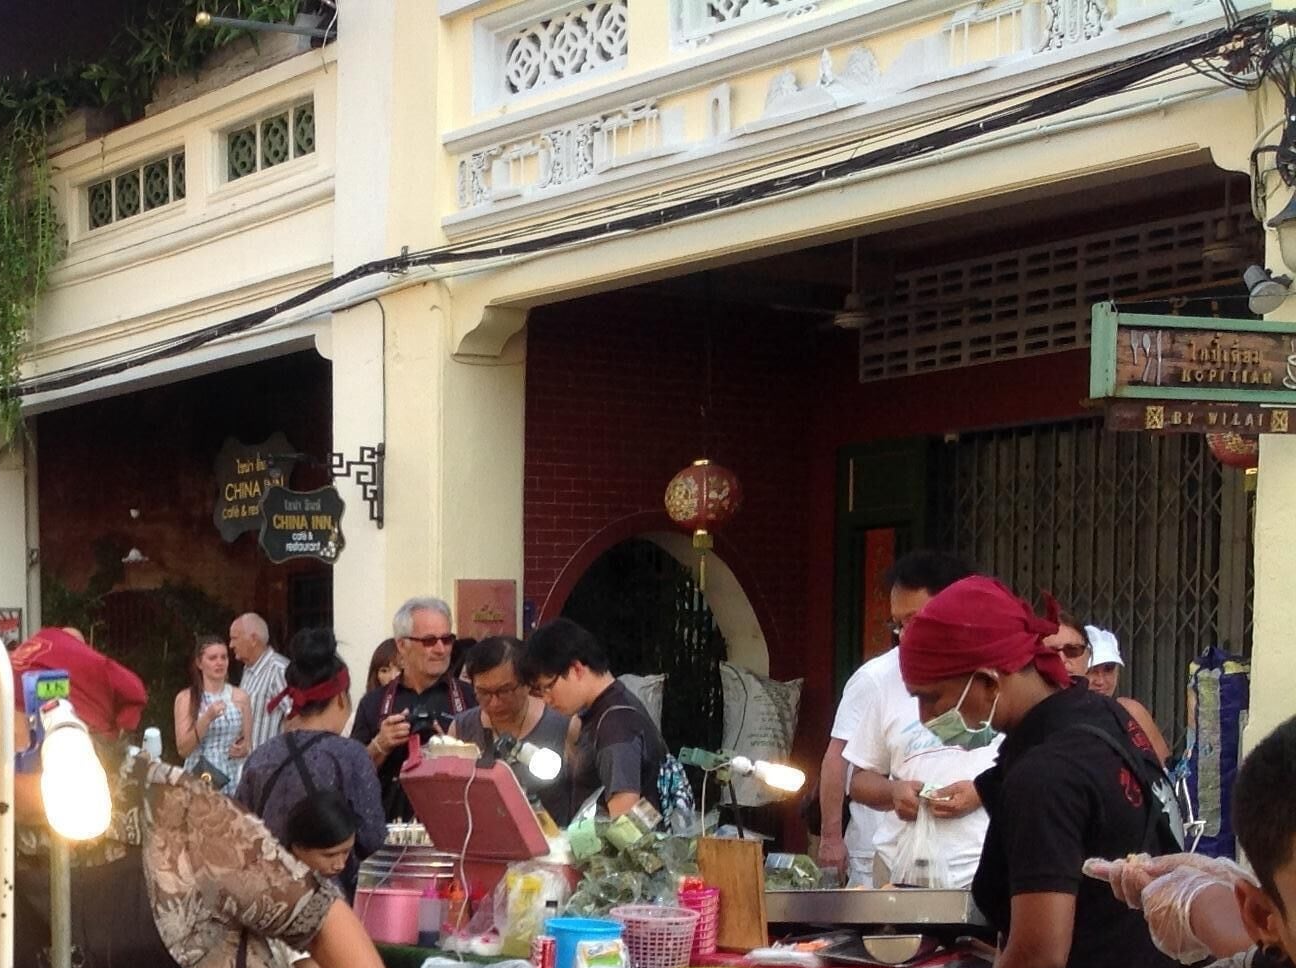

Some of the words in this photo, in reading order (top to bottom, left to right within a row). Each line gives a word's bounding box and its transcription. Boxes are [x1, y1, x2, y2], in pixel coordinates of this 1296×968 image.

[1181, 367, 1273, 385] KOPITIAM
[1172, 410, 1194, 425] BY
[1207, 411, 1265, 427] WILAI
[225, 480, 262, 502] CHINA
[240, 504, 248, 517] &
[272, 513, 309, 530] CHINA
[311, 514, 332, 530] INN
[285, 541, 321, 552] restaurant
